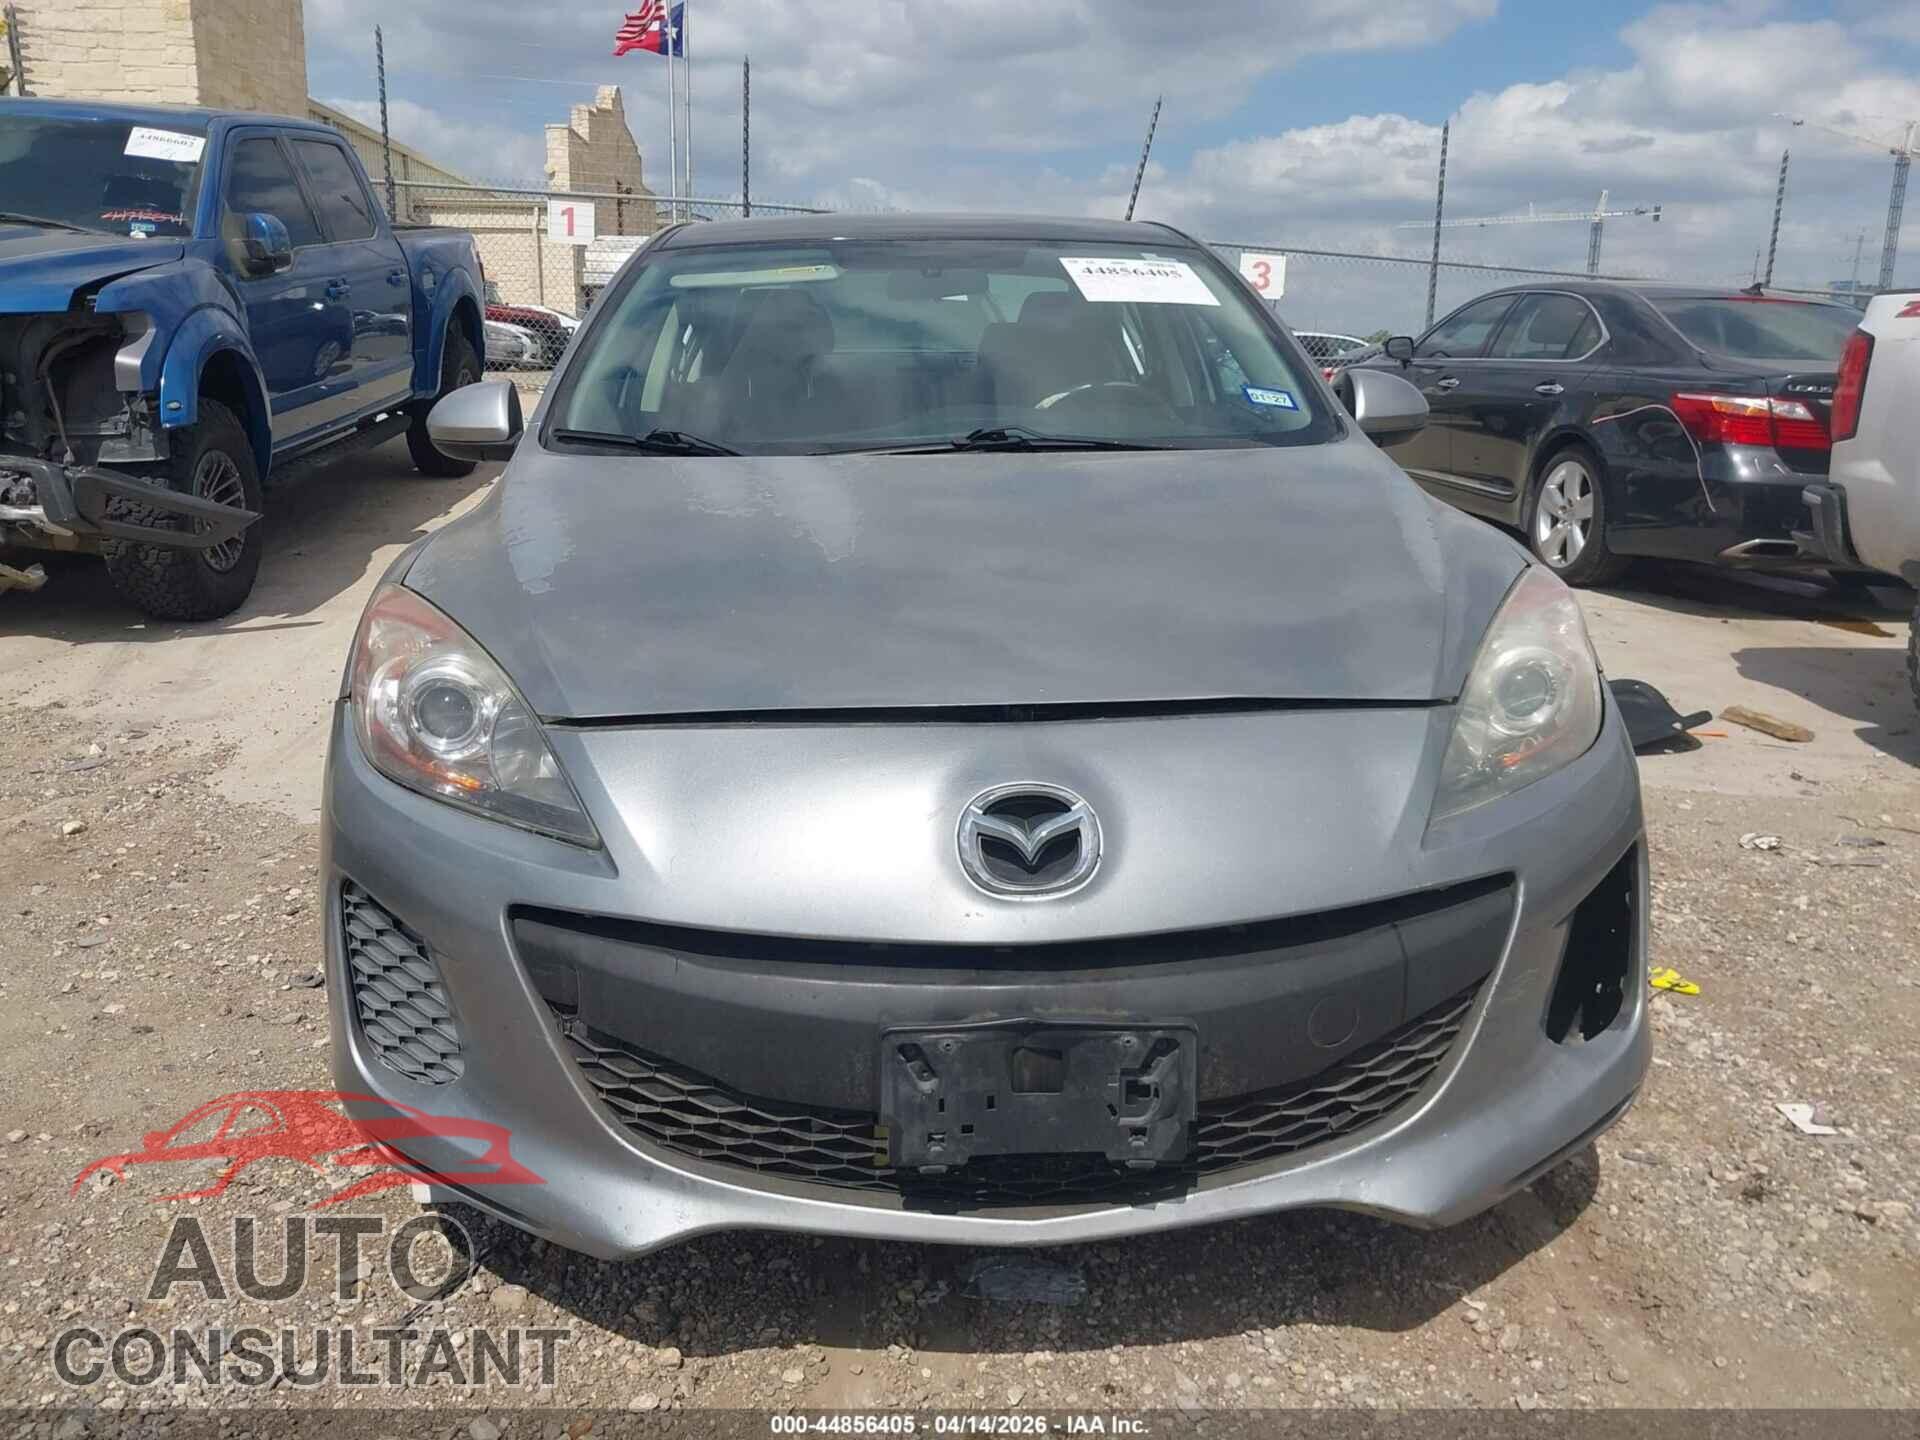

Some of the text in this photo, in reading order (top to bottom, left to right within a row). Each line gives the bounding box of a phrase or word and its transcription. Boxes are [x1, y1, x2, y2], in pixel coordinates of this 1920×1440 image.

[561, 207, 574, 236] 1
[1082, 266, 1182, 279] 44856405
[1252, 261, 1271, 290] 3
